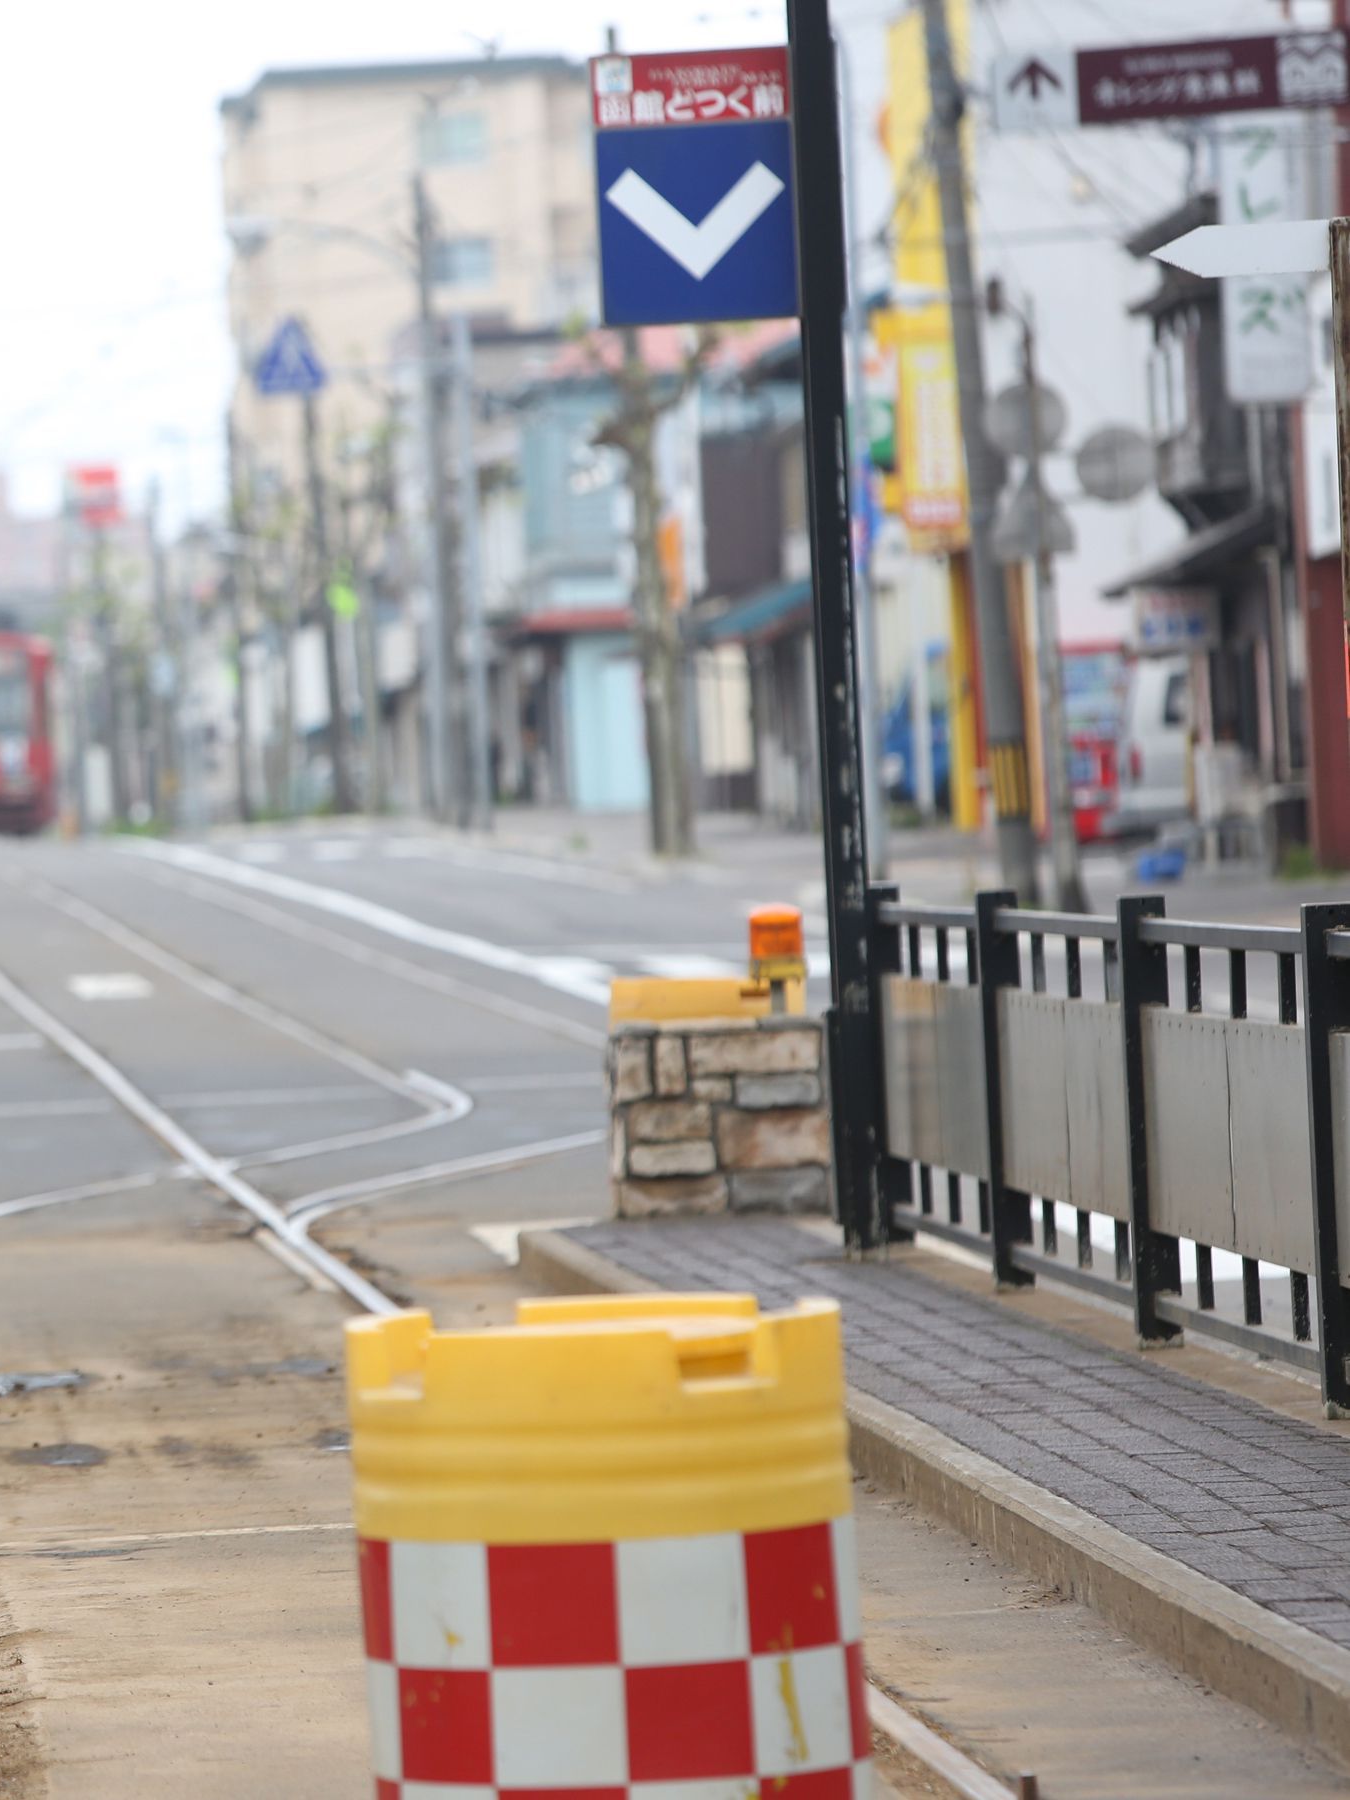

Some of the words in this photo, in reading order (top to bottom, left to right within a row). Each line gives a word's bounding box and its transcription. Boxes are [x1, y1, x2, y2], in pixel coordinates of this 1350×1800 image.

[598, 83, 785, 126] 函館どつく前
[1234, 126, 1306, 336] フレズ
